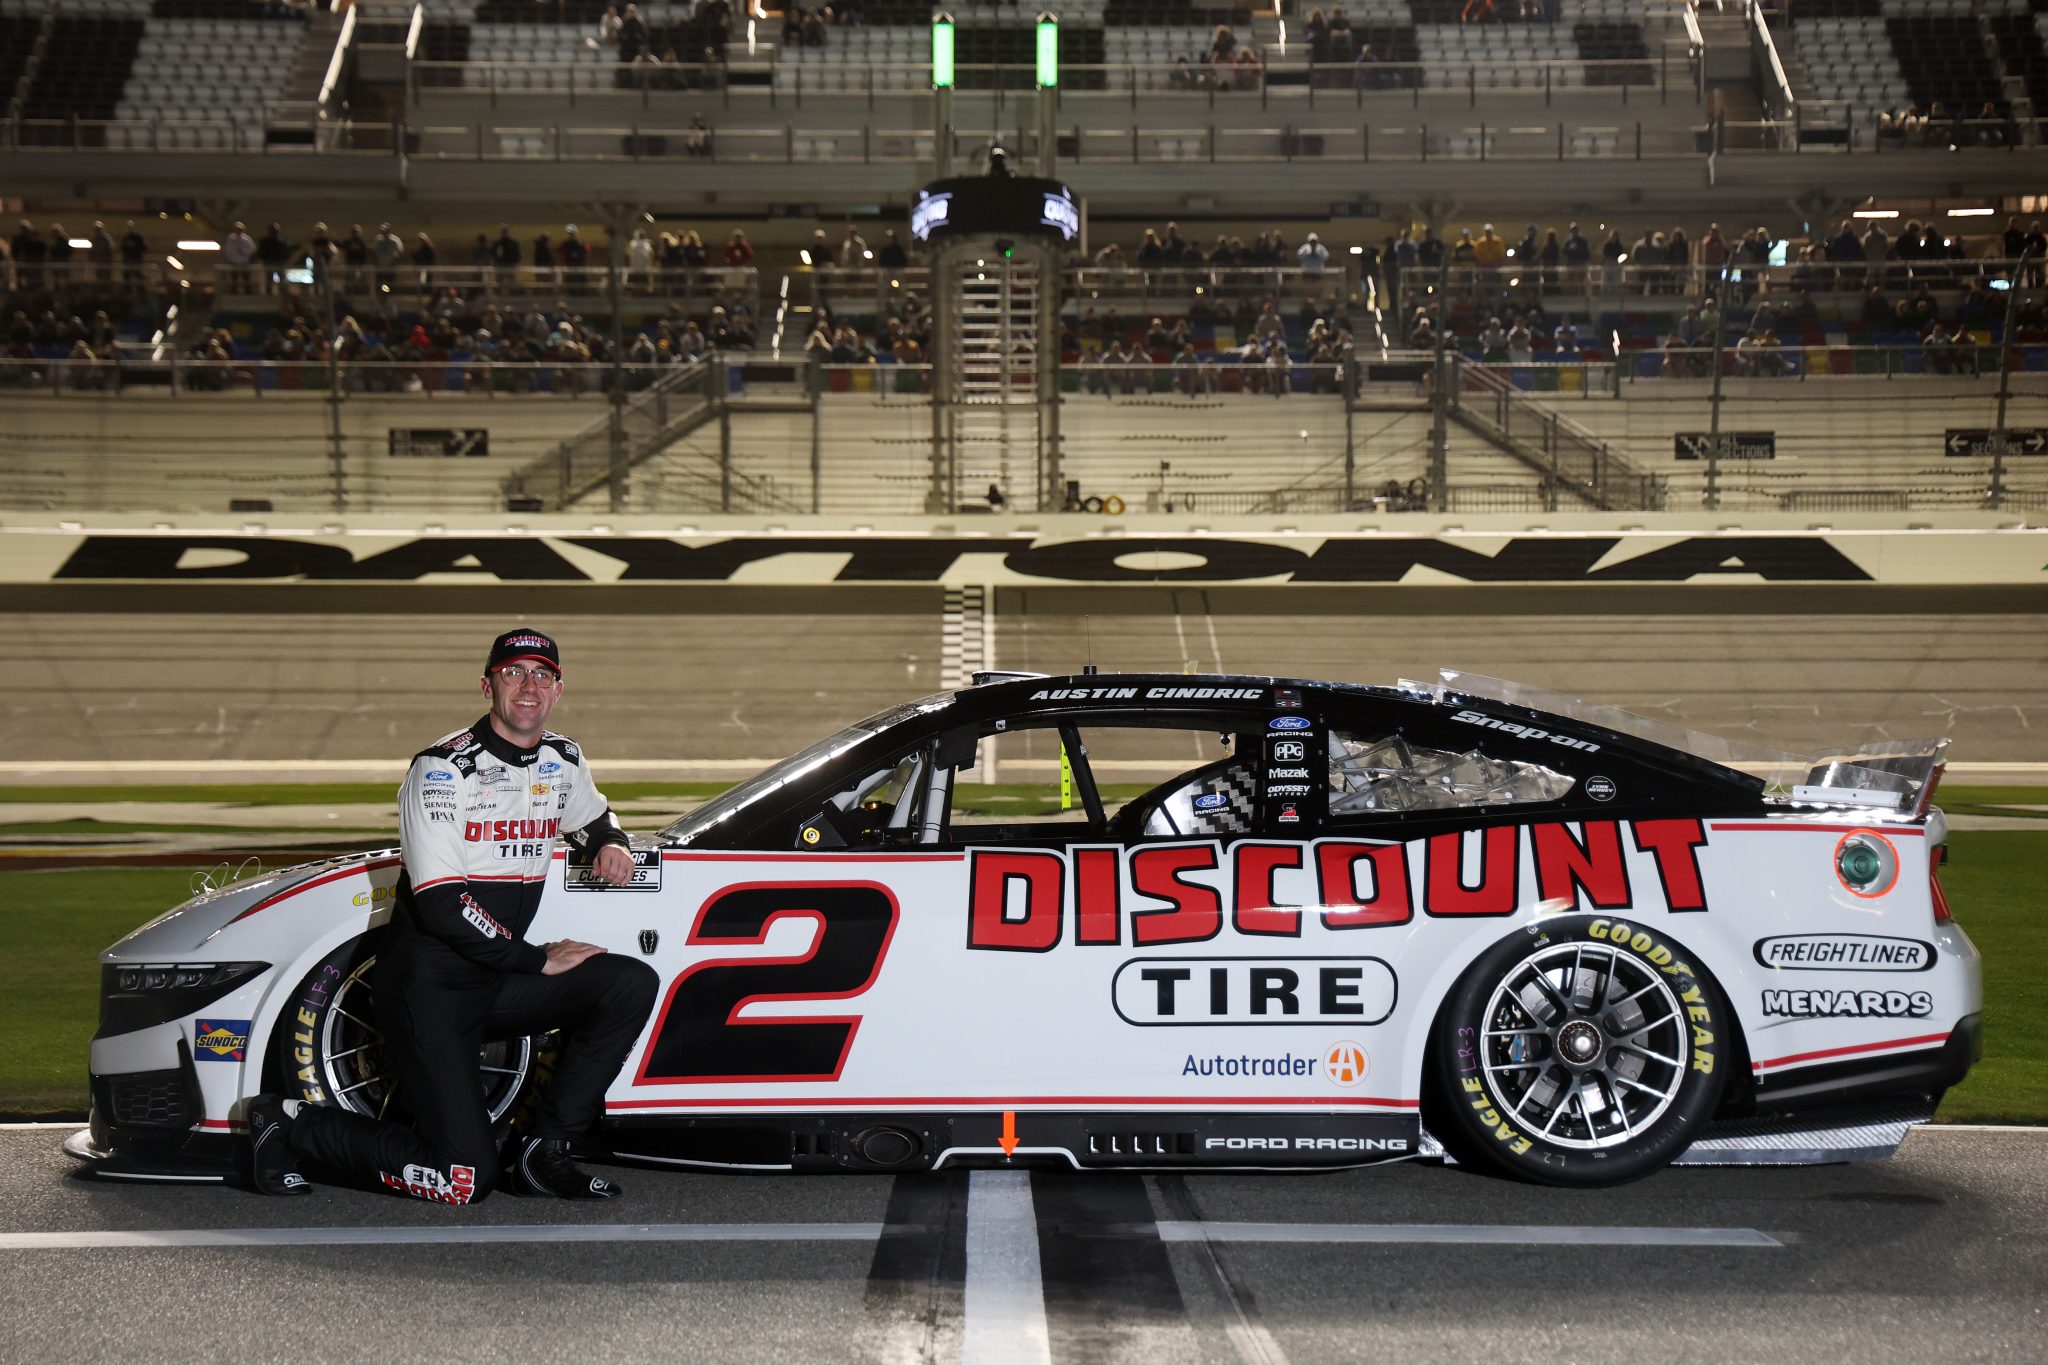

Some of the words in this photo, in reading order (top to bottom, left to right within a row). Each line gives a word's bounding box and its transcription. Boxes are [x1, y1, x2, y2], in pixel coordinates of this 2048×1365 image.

[52, 536, 1875, 582] DAYTONA
[1029, 687, 1138, 700] AUSTIN
[1146, 688, 1263, 699] CINDRIC
[1276, 743, 1302, 759] PPG
[1268, 767, 1309, 779] Mazak
[1267, 784, 1311, 793] ODYSSEY
[424, 801, 457, 810] SIEMENS
[1195, 806, 1230, 815] RACING
[465, 817, 561, 842] DISCOUN
[499, 843, 544, 858] TIRE
[966, 818, 1710, 953] DISCOUNT
[467, 909, 493, 935] TIRE
[1769, 942, 1920, 964] FREIGHTLINER
[632, 879, 900, 1087] 2
[1141, 967, 1364, 1015] TIRE
[1761, 989, 1934, 1018] MENARDS
[199, 1036, 248, 1047] SUNOCO
[1458, 1027, 1477, 1072] LR-3
[294, 1006, 327, 1102] EAGLE
[1182, 1053, 1318, 1077] Autotrader
[1461, 1077, 1534, 1156] EAGLE
[1205, 1137, 1289, 1149] FORD
[1295, 1138, 1408, 1150] RACING
